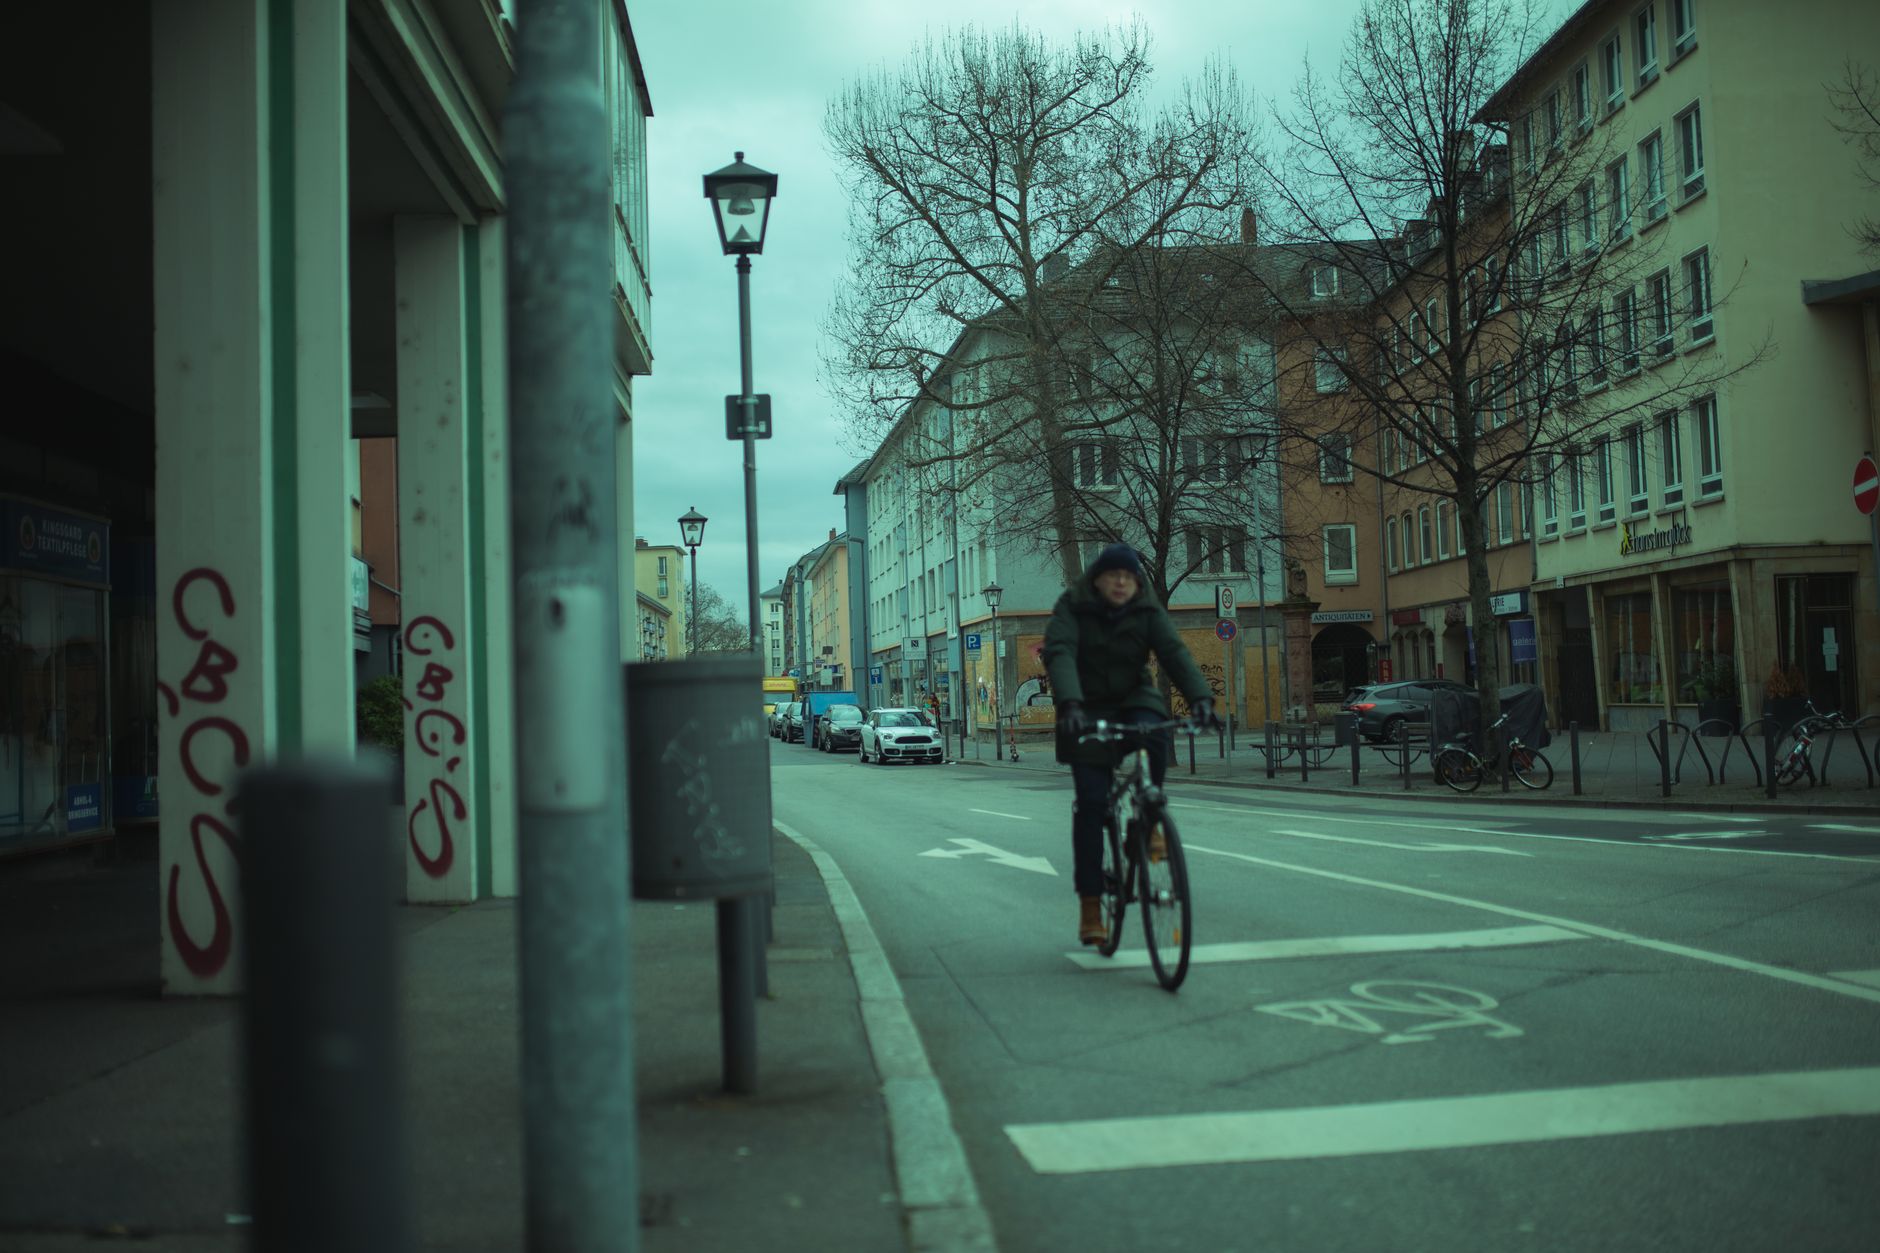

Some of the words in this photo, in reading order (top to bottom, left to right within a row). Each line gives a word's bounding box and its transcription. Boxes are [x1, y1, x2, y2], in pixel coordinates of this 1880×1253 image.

[37, 536, 88, 559] TEXTILPFLEGE
[1223, 593, 1232, 604] 30
[1313, 612, 1366, 622] ANTIQUITÄTEN
[968, 636, 977, 648] P
